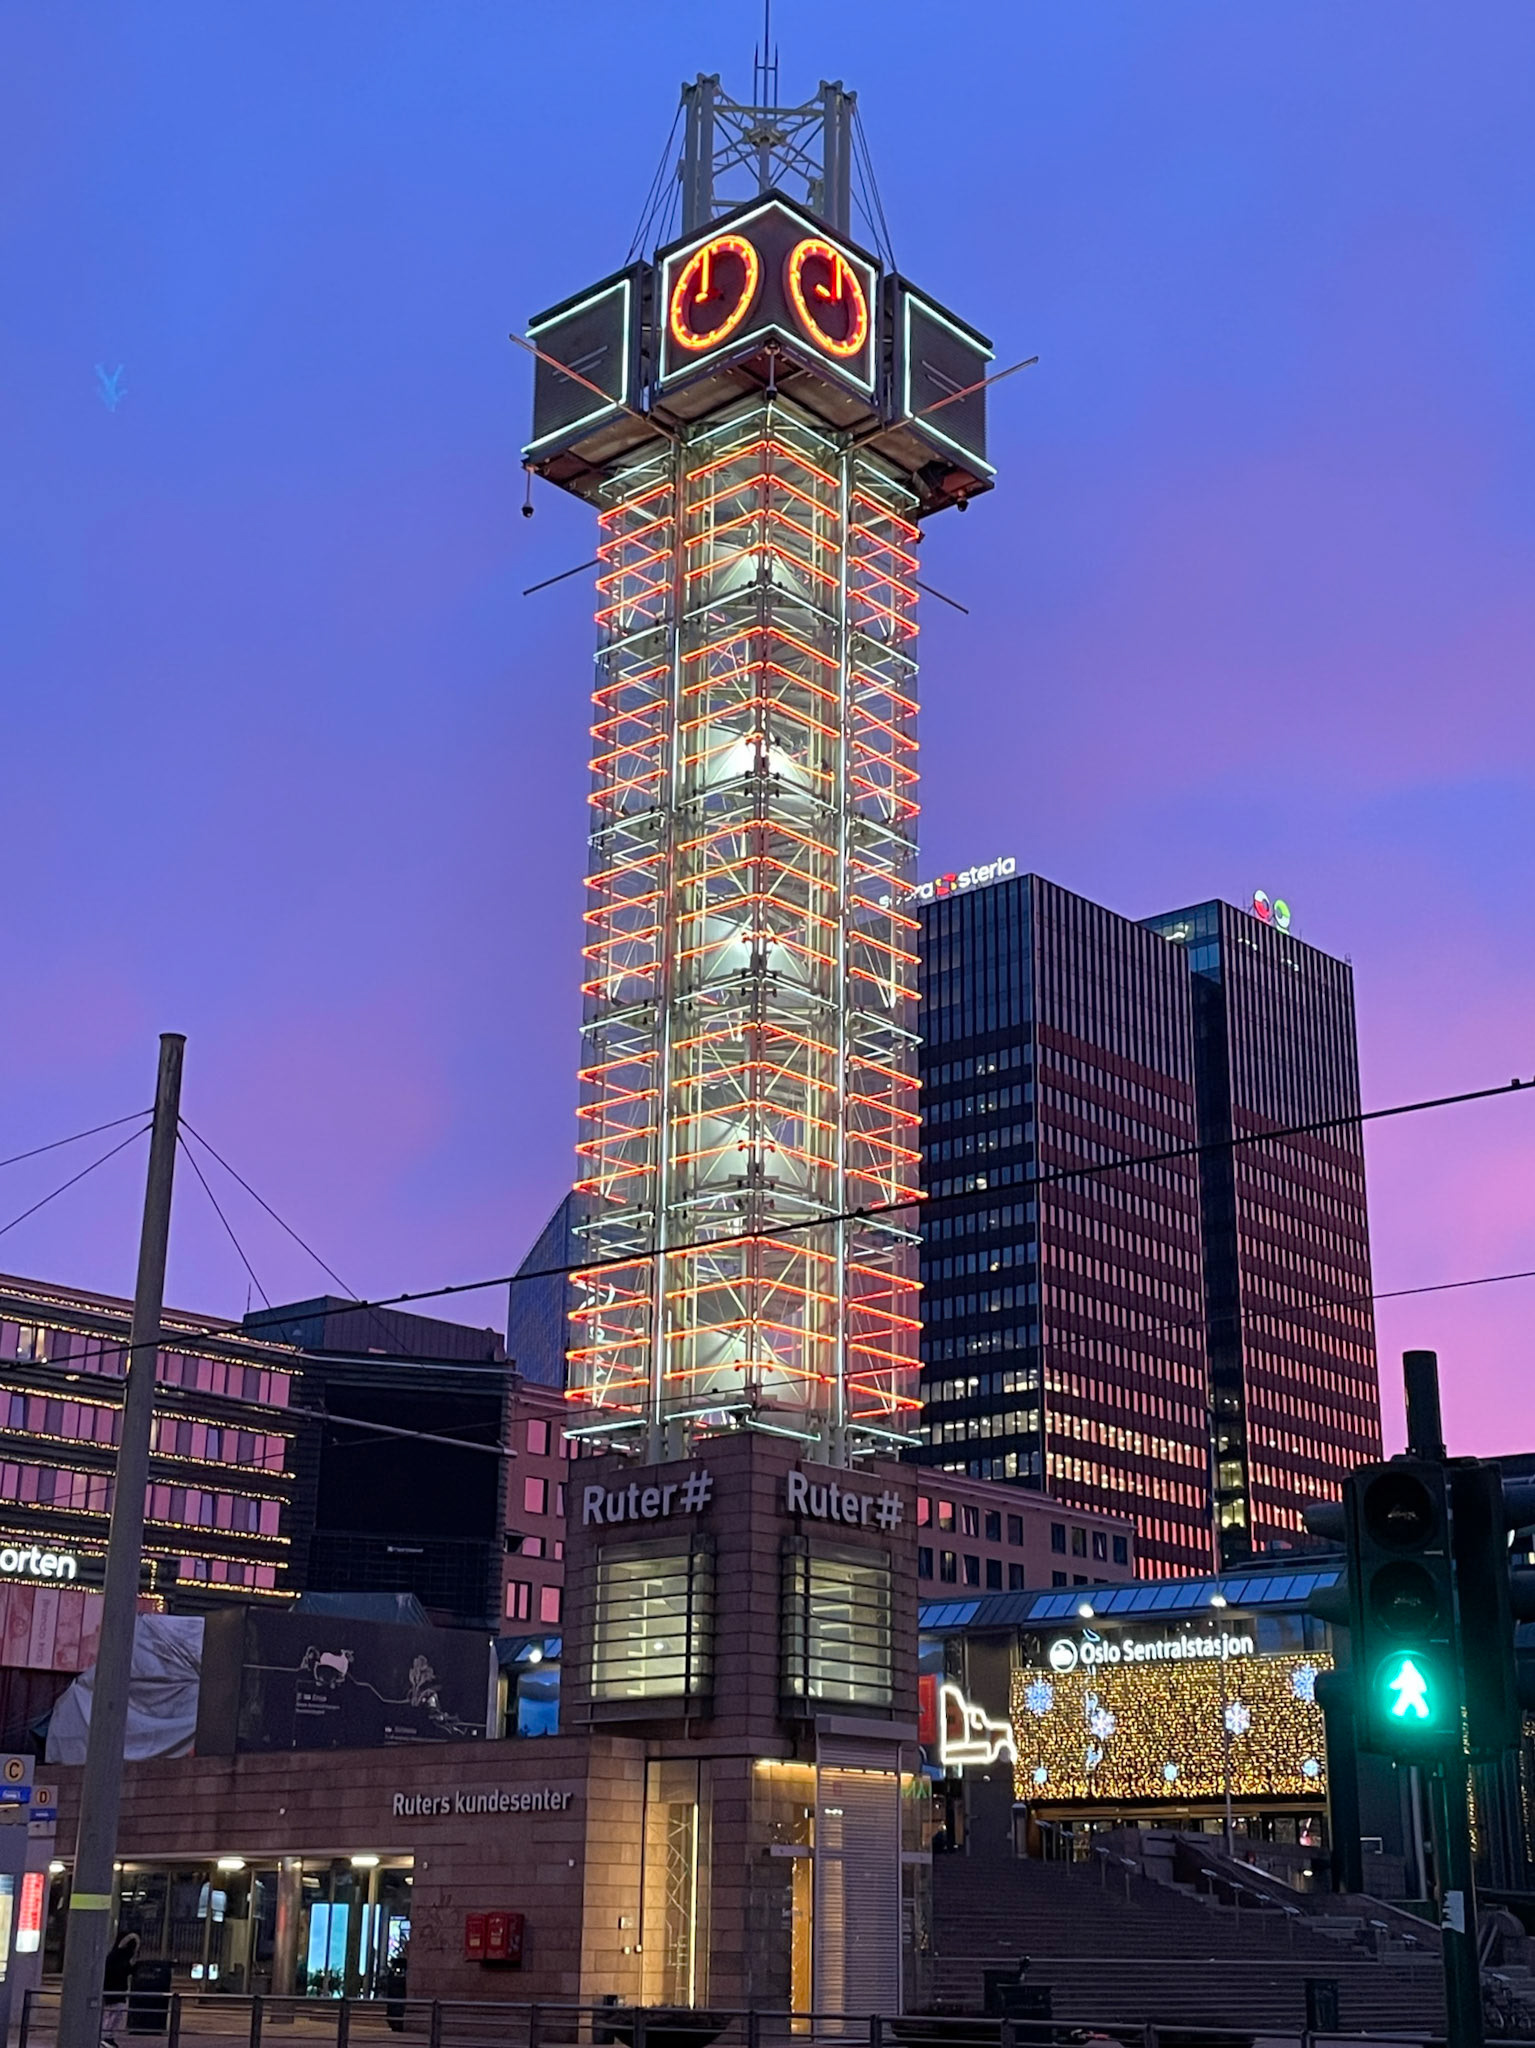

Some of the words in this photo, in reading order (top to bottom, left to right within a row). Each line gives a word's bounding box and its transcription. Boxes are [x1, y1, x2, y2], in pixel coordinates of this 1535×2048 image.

[879, 882, 934, 909] sra
[957, 857, 1016, 889] steria
[583, 1470, 713, 1526] Ruter#
[788, 1470, 904, 1530] Ruter#
[0, 1546, 77, 1580] orten
[1080, 1640, 1121, 1665] Oslo
[1123, 1632, 1254, 1663] Sentralstasjon
[9, 1762, 20, 1778] C
[39, 1791, 48, 1804] D
[393, 1792, 451, 1816] Ruters
[455, 1787, 572, 1814] kundesenter
